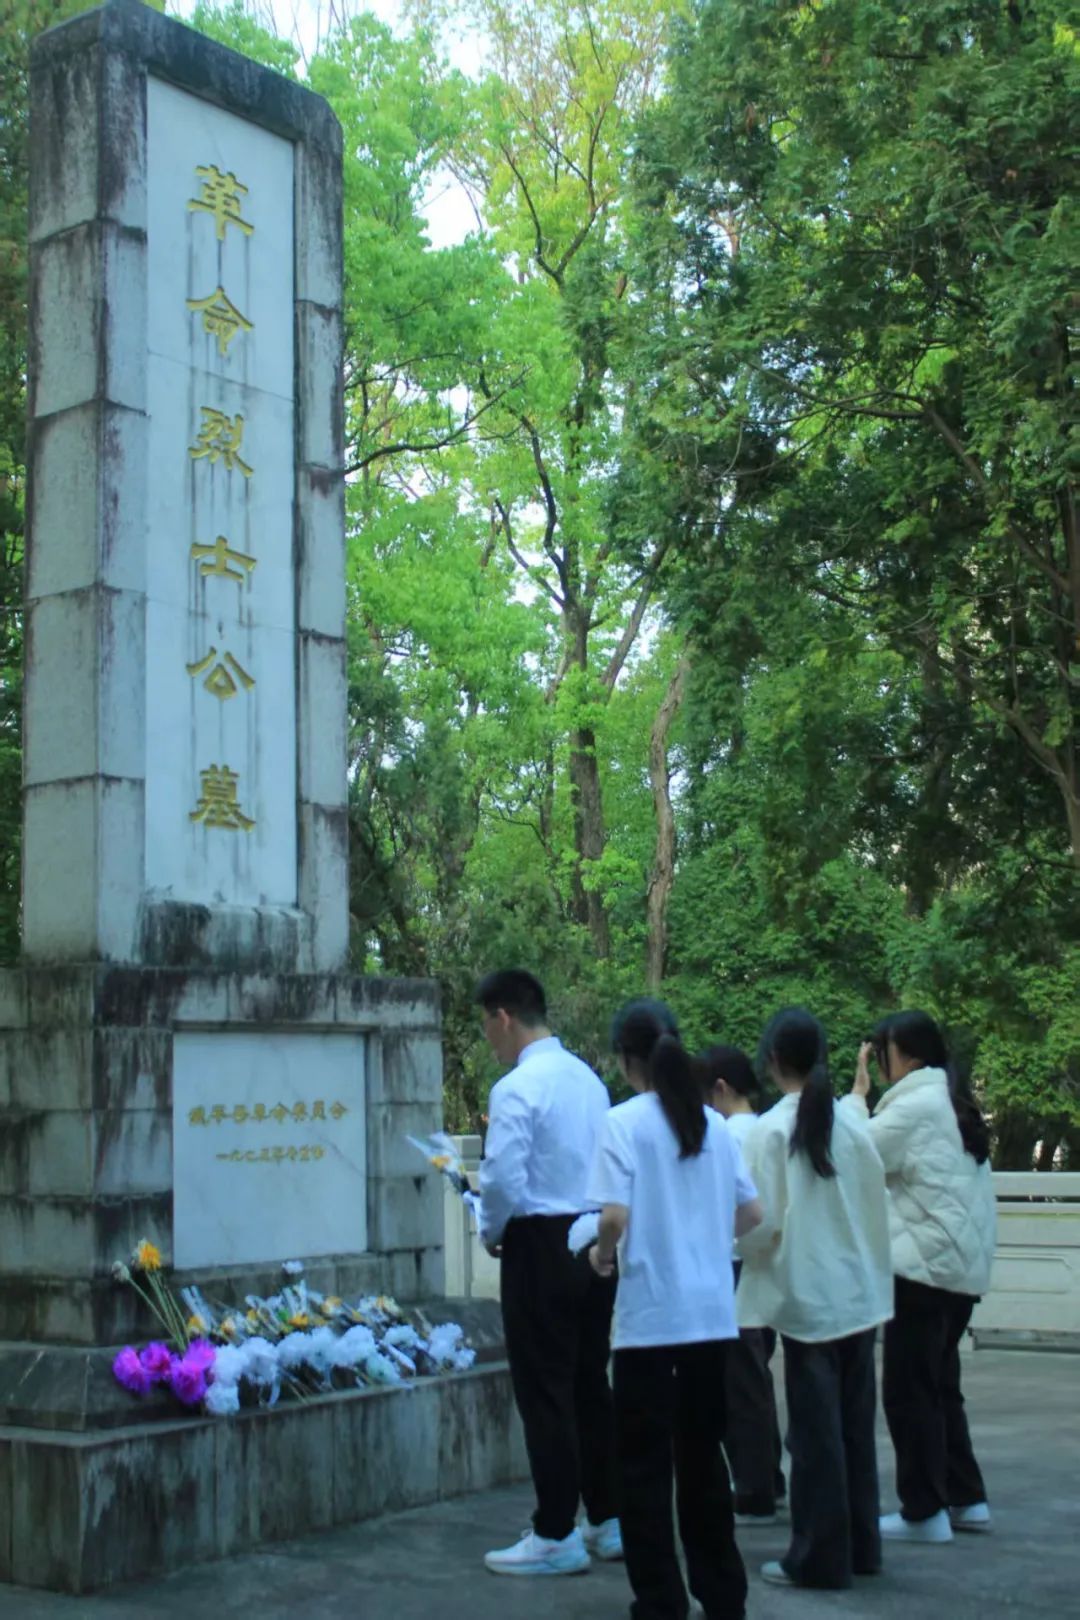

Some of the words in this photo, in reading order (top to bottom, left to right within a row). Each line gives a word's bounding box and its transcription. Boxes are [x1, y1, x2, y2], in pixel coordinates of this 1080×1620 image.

[186, 164, 256, 832] 革命烈士公墓
